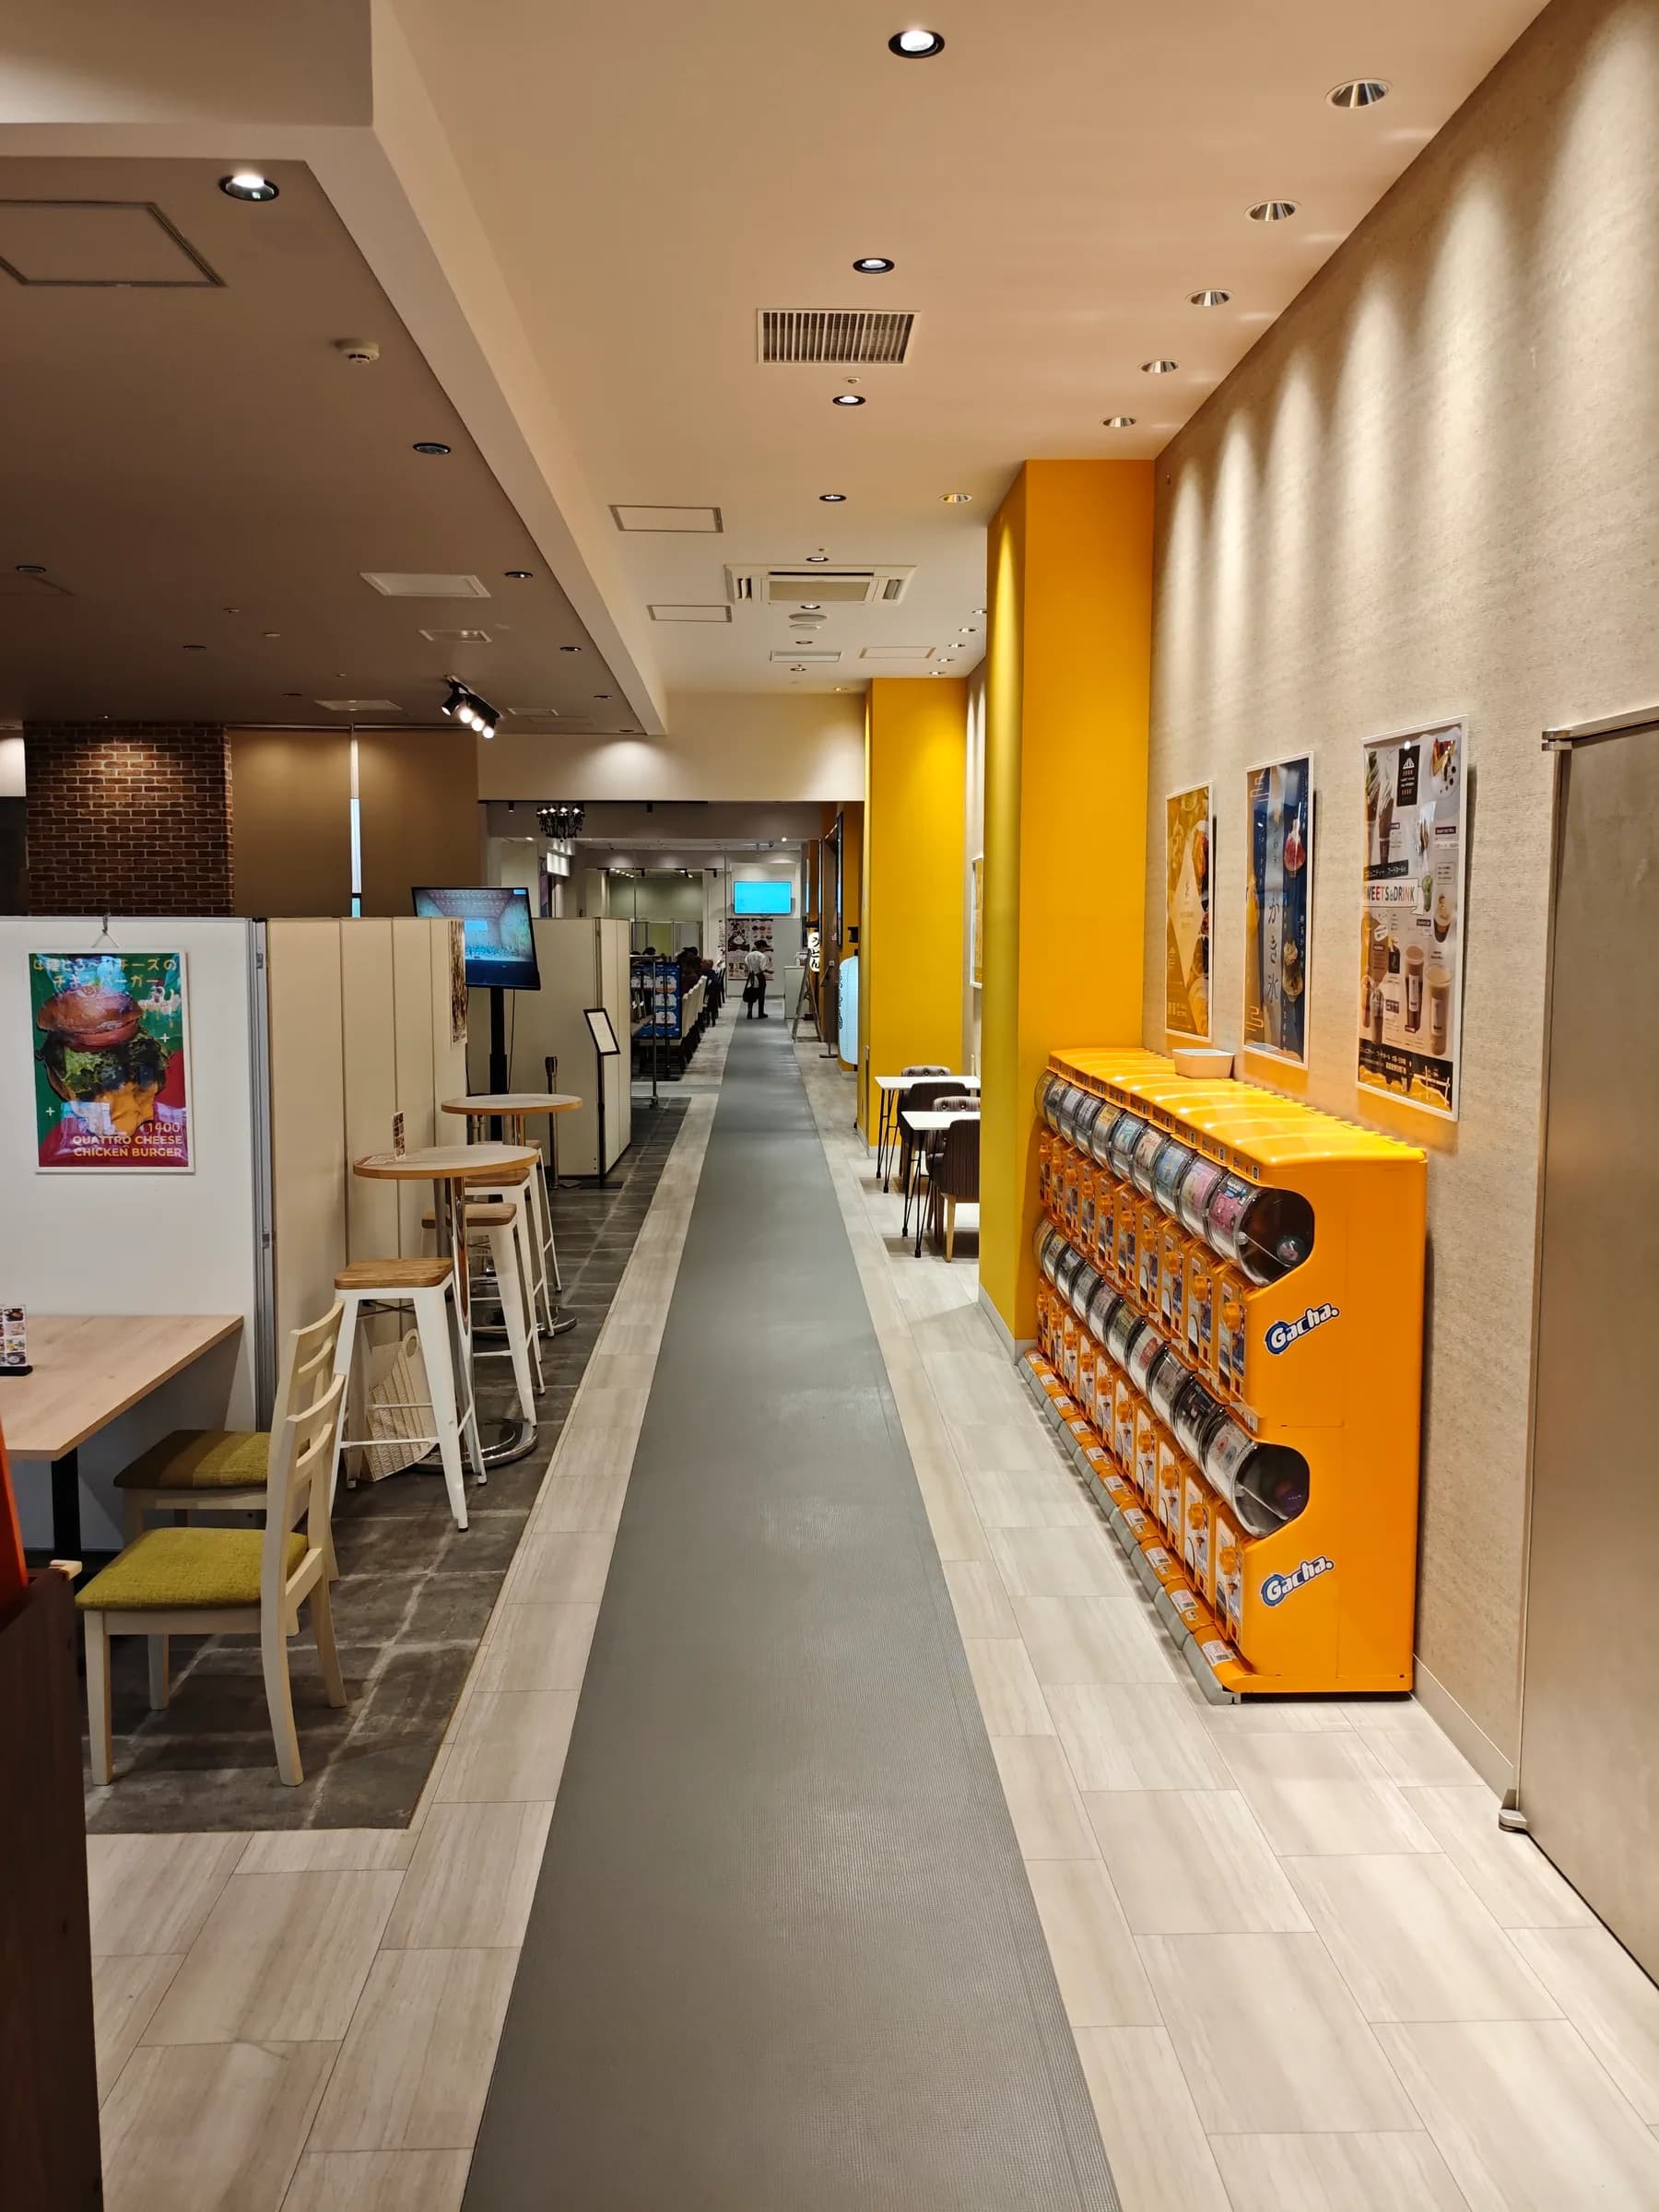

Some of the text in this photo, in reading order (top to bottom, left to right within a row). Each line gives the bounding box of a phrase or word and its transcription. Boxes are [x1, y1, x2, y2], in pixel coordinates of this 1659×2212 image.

[73, 1135, 182, 1146] QUATTRO CHEESE
[74, 1147, 182, 1158] CHICKEN BURGER
